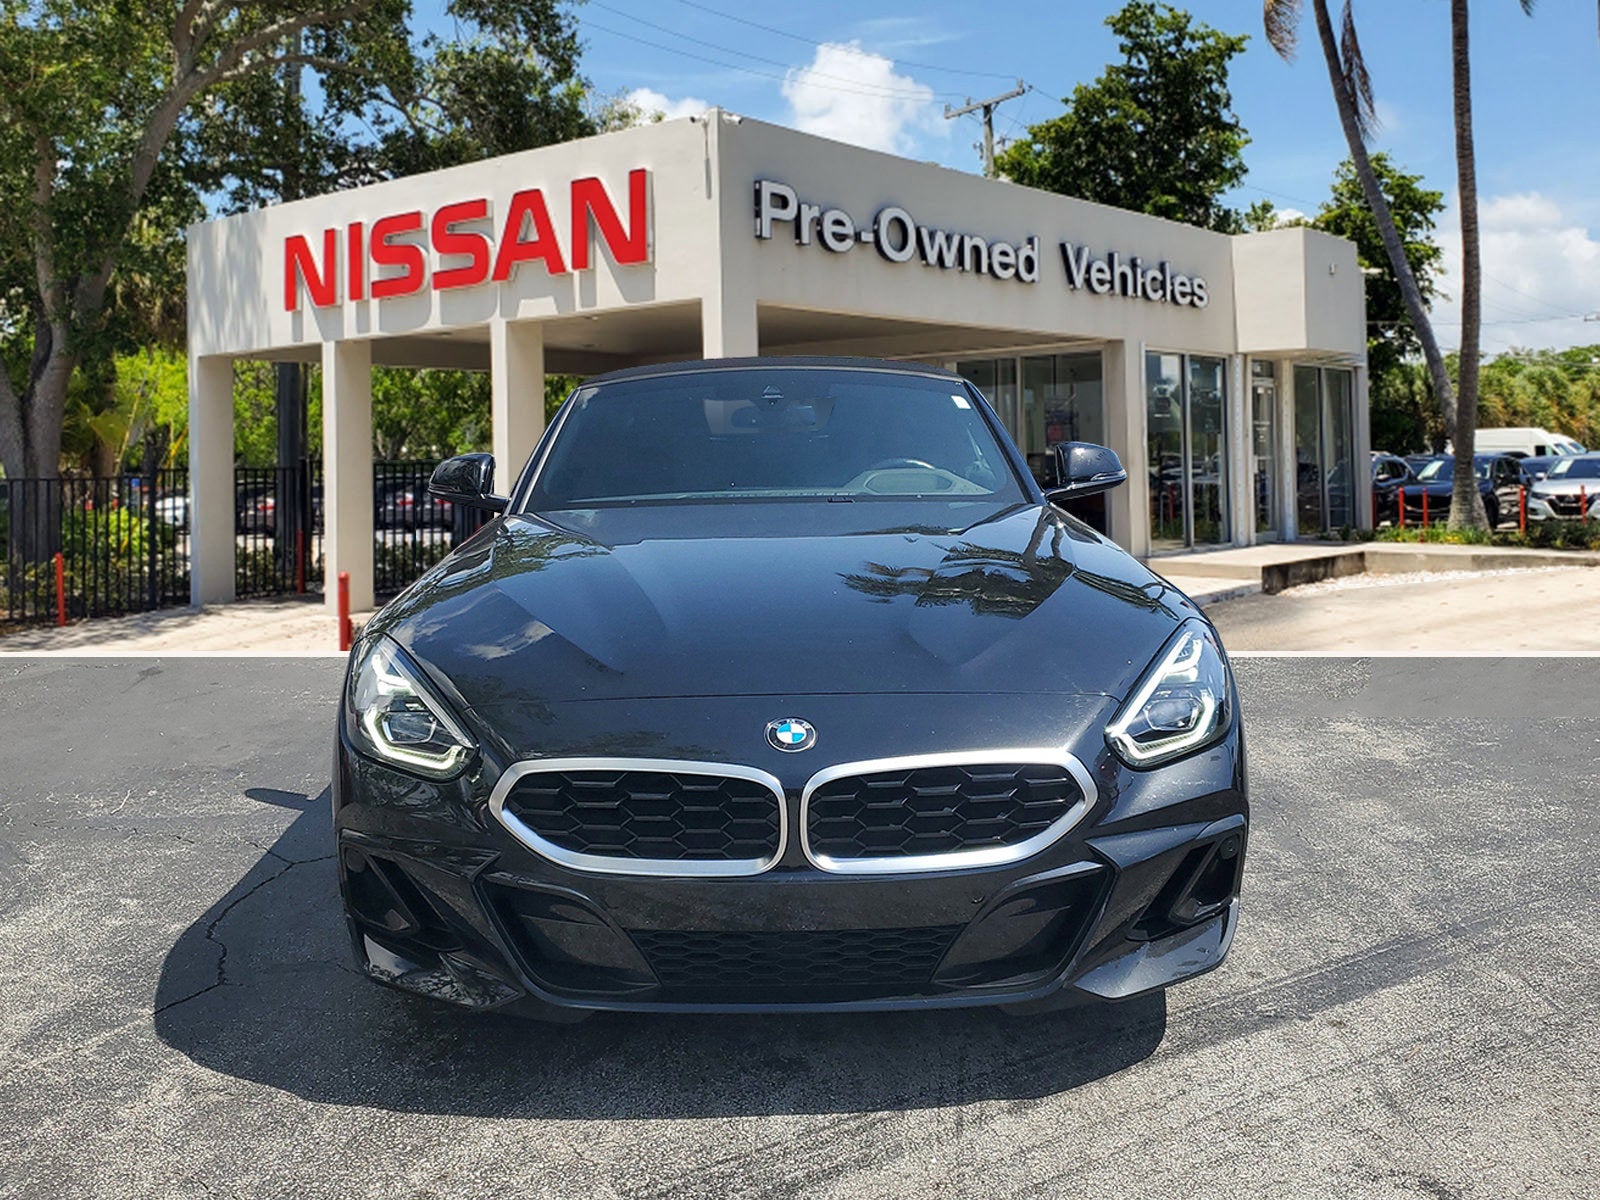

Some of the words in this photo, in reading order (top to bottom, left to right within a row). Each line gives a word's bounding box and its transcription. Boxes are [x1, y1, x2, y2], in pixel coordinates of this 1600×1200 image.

[285, 168, 647, 311] NISSAN
[755, 180, 1040, 283] Pre-Owned
[1061, 241, 1209, 308] Vehicles
